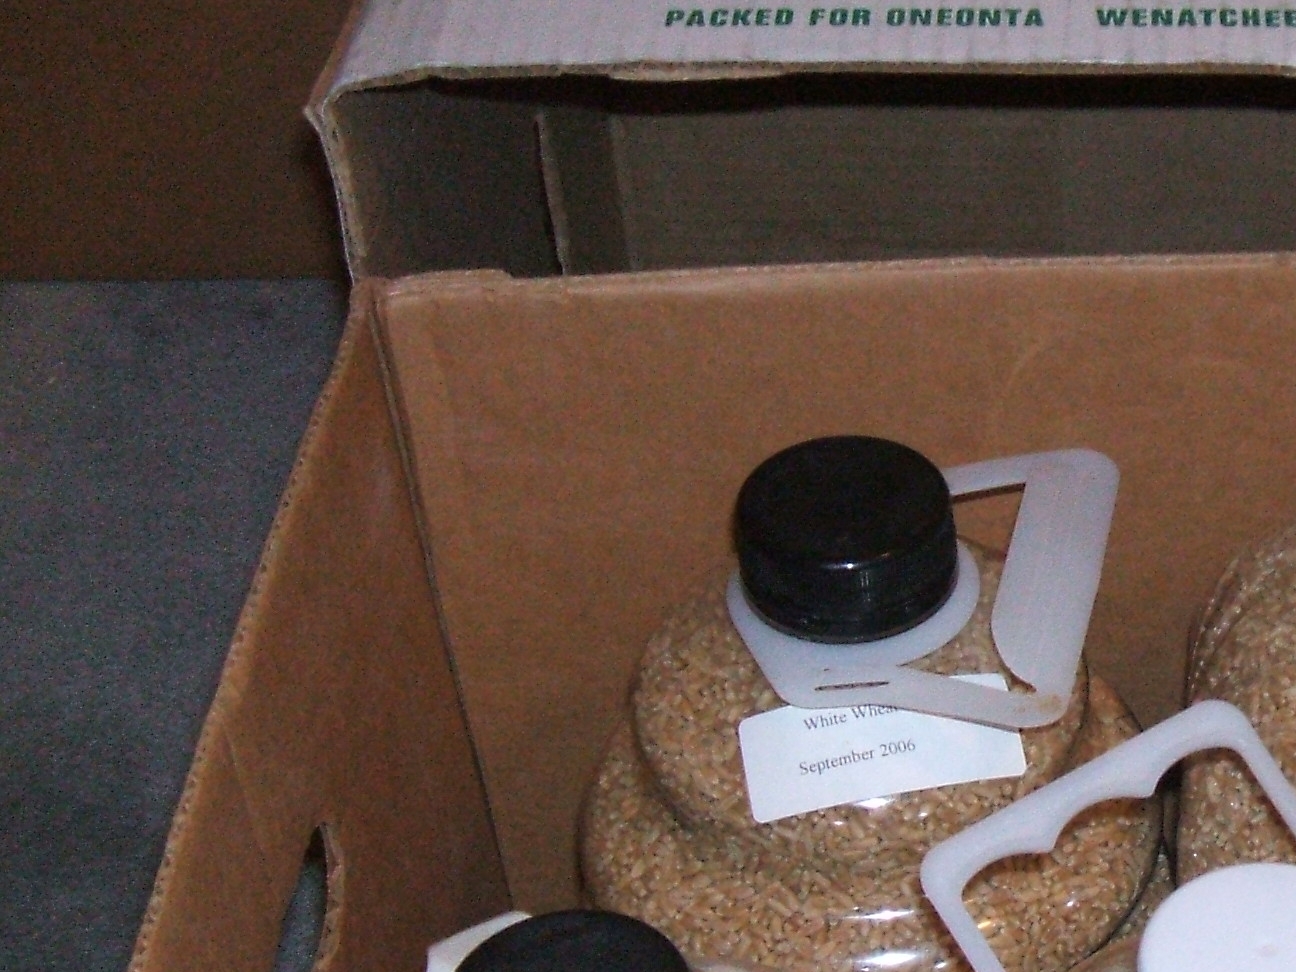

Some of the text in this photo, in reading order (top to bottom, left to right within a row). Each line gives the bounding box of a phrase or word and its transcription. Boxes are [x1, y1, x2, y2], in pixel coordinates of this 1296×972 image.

[664, 7, 795, 27] PACKED
[807, 6, 872, 26] FOR
[885, 7, 1045, 28] ONEONTA
[803, 704, 899, 730] White Whea
[799, 739, 917, 776] September 2006
